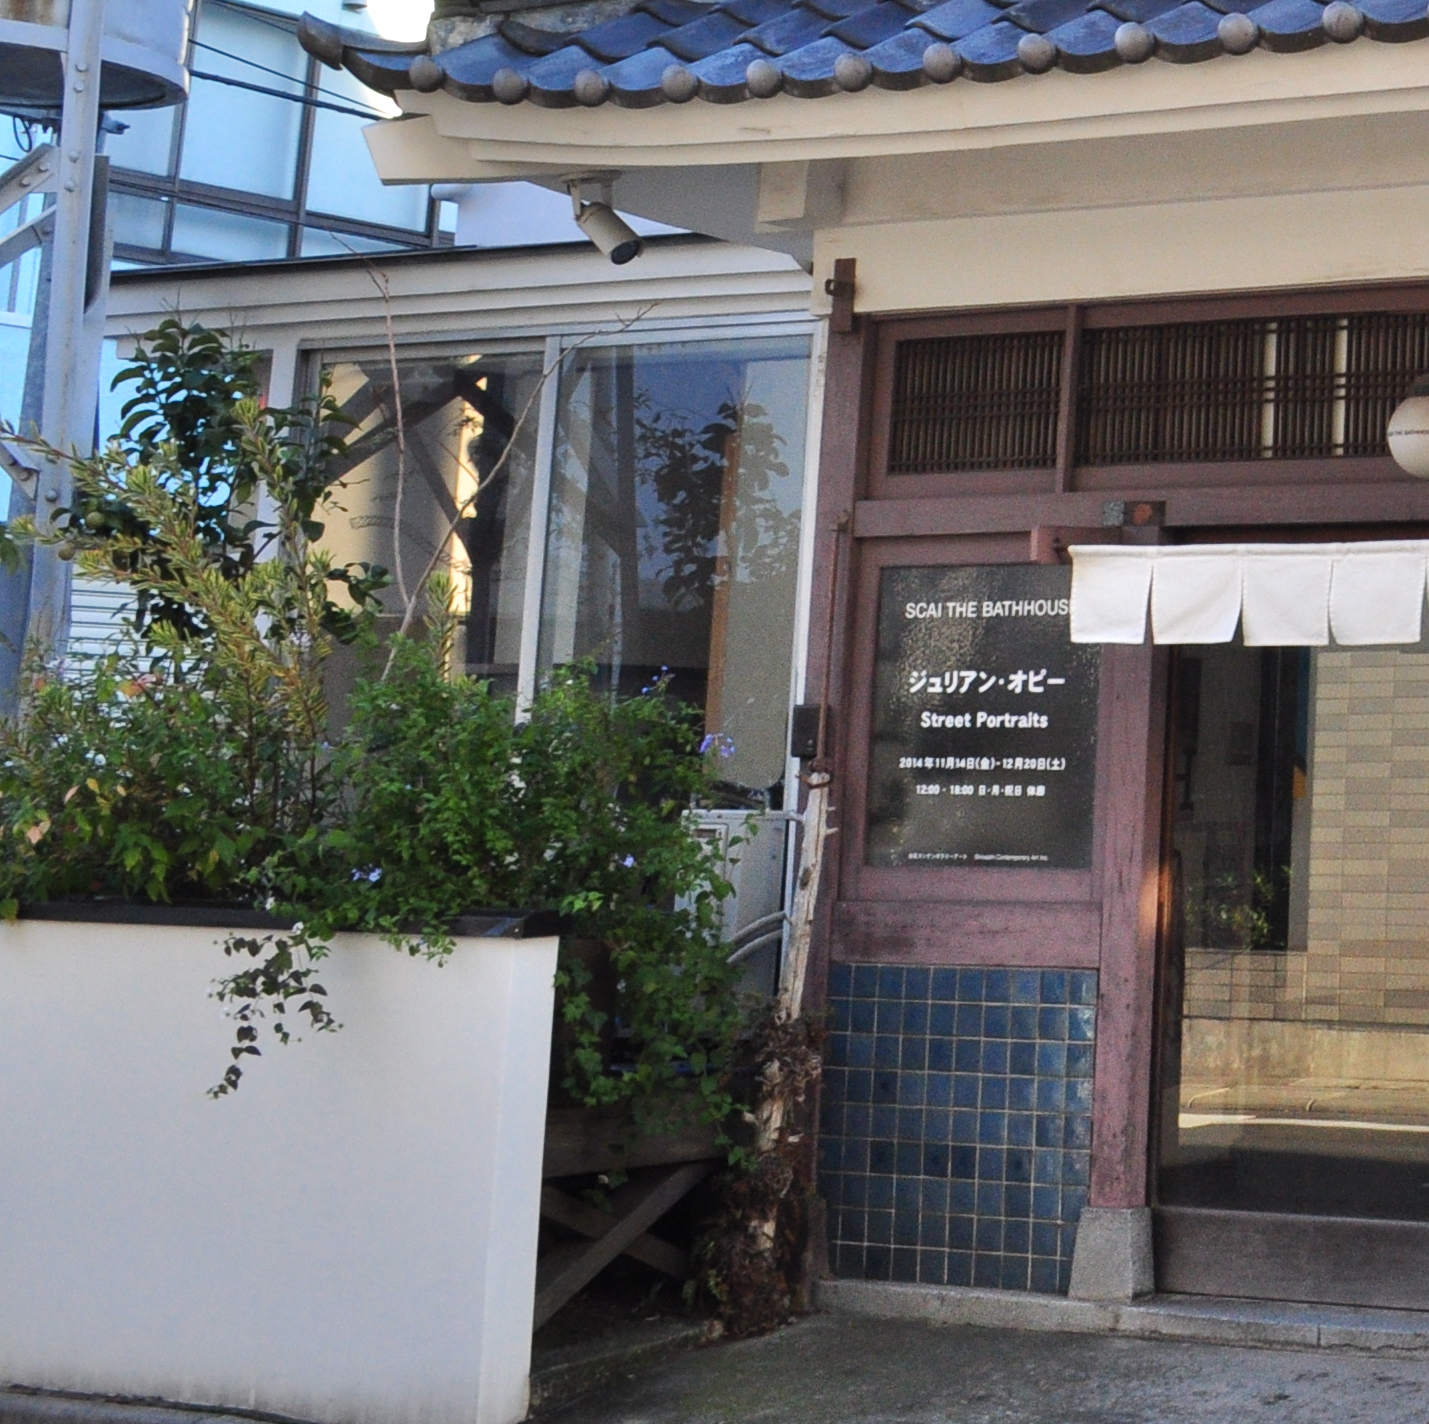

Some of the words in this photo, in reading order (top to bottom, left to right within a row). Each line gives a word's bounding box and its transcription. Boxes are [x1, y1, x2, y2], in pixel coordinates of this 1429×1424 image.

[905, 602, 942, 619] SCAI
[946, 601, 977, 618] THE
[982, 598, 1071, 617] BATHHOUS
[908, 668, 1066, 694] ジュリアン・オピー
[920, 711, 972, 728] Street
[976, 711, 1049, 728] Portraits
